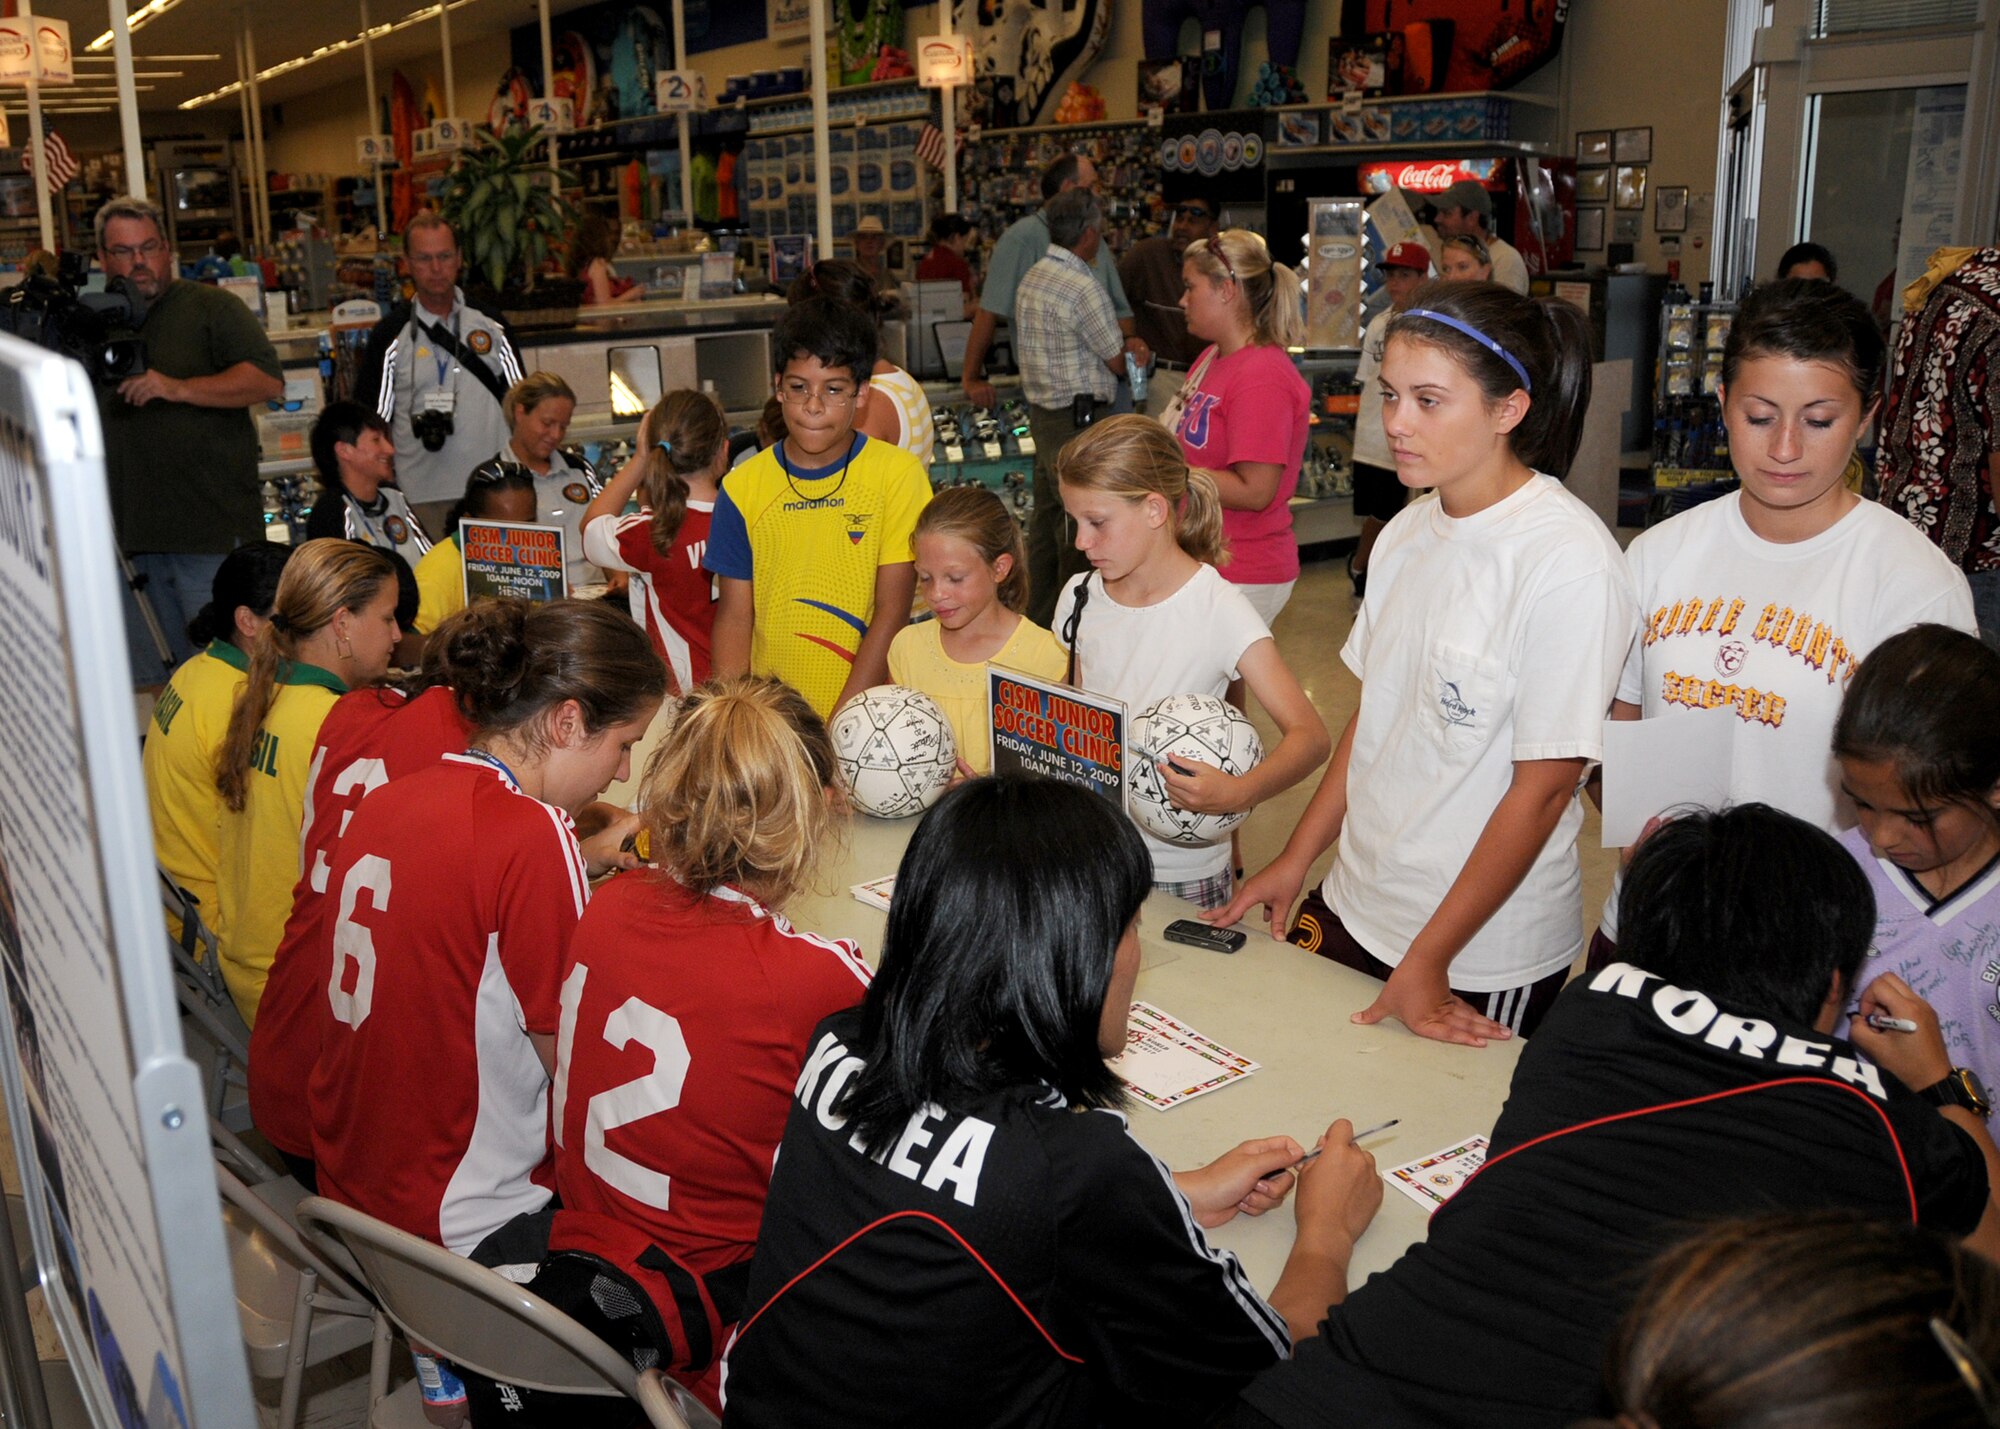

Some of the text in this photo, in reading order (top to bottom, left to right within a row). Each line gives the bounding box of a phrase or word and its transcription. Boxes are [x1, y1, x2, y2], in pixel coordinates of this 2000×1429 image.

[538, 102, 551, 121] 4
[667, 75, 683, 98] 2
[783, 498, 844, 511] marathon
[466, 543, 561, 568] SOCCER CLINIC
[468, 527, 556, 550] CISM JUNIOR
[467, 563, 498, 574] FRIDAY,
[500, 566, 522, 576] JUNE
[538, 570, 560, 579] 2009
[999, 680, 1115, 741] CISM JUNIOR
[1440, 697, 1476, 717] Hard Rock
[1661, 671, 1788, 728] SOCCER
[994, 704, 1121, 771] SOCCER CLINIC
[996, 733, 1120, 788] FRIDAY, JUNE 12, 2009
[328, 853, 391, 1031] 6
[1588, 962, 1888, 1101] KOREA
[552, 960, 692, 1212] 12
[794, 1031, 996, 1208] KOEA
